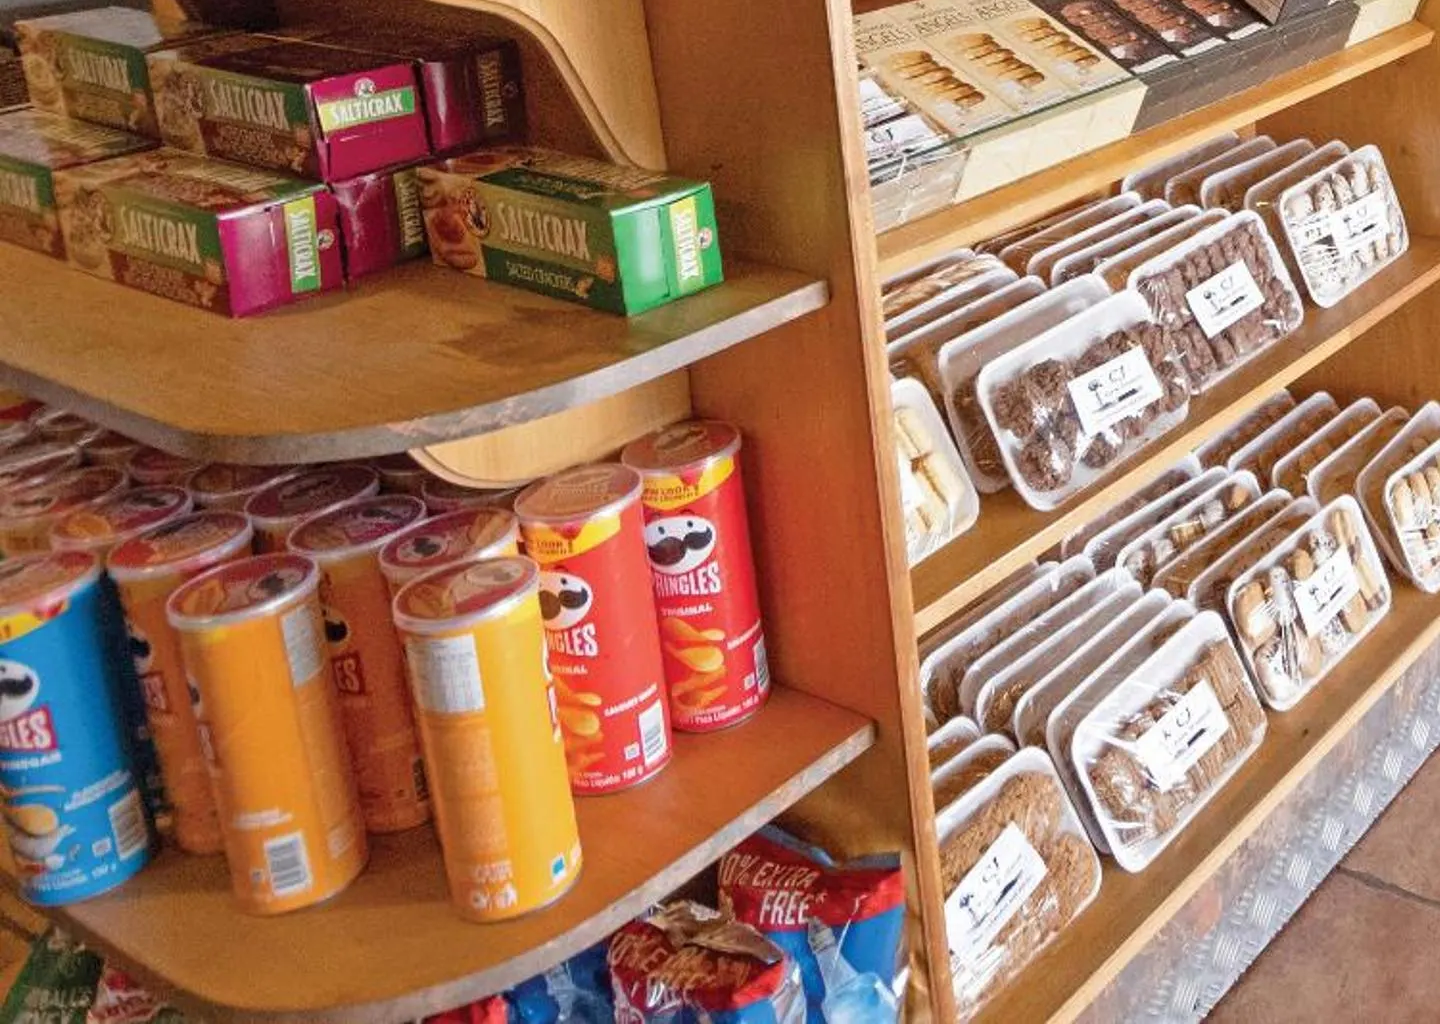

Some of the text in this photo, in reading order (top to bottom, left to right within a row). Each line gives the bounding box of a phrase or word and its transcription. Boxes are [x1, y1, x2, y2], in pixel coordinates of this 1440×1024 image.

[209, 79, 290, 130] SALTICRAX
[331, 93, 404, 125] SALTICRAX
[120, 206, 201, 265] SALTICRAX
[290, 210, 317, 281] SALTICRAX
[498, 202, 591, 262] SALTICRAX
[675, 211, 700, 281] SALTICRAX
[751, 860, 822, 889] EXTRA
